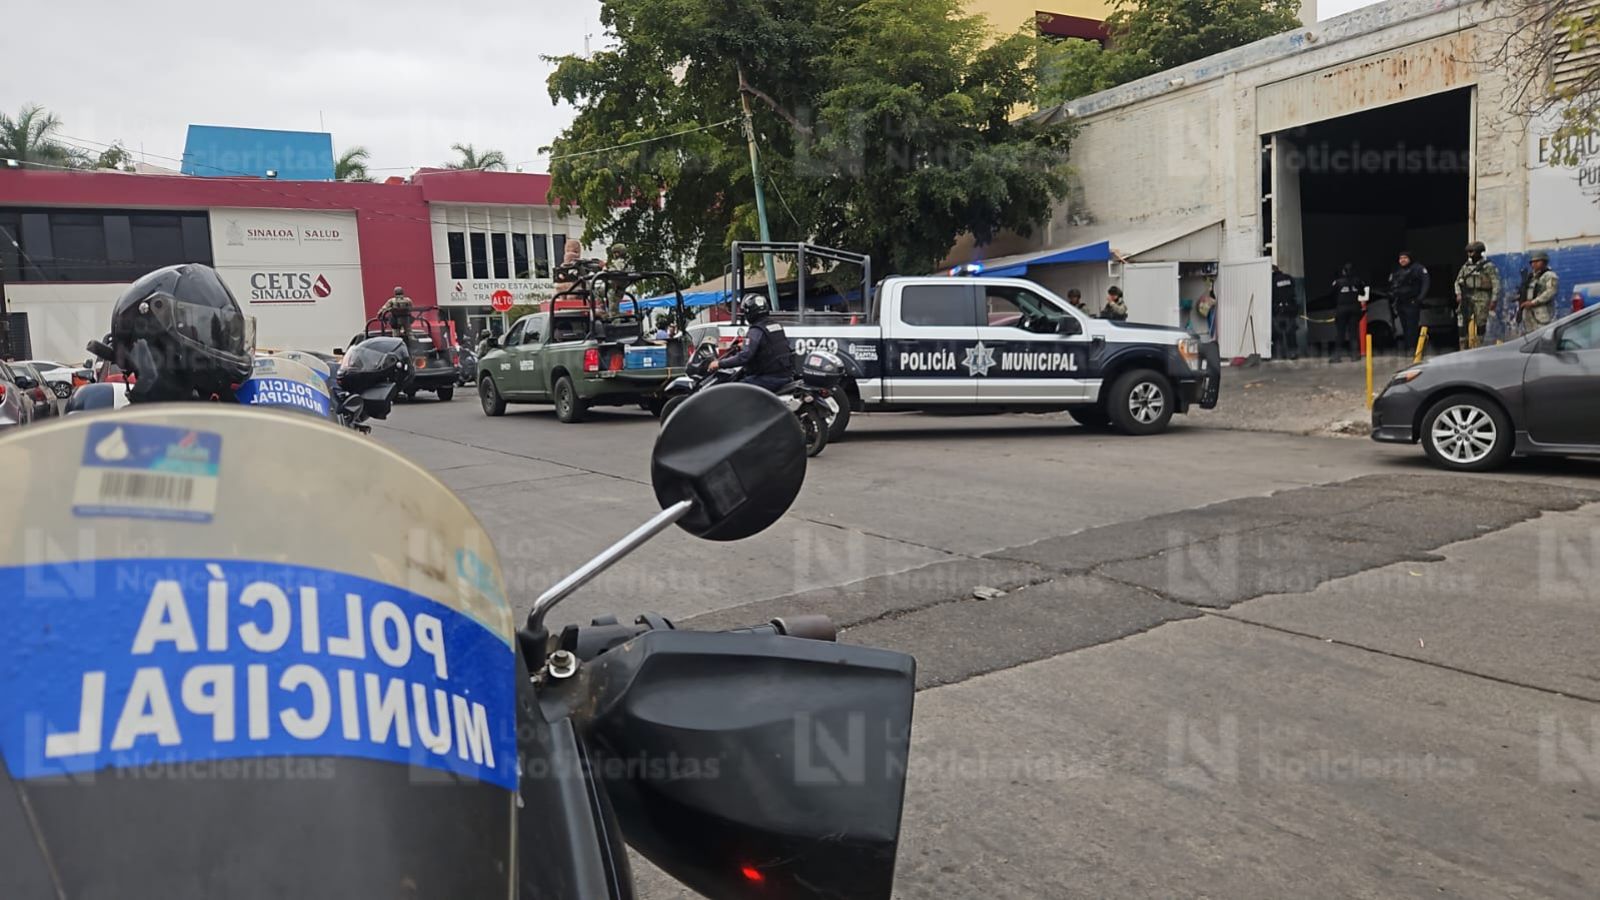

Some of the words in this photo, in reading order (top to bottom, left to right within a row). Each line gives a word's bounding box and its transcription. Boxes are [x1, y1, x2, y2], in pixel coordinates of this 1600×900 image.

[247, 229, 294, 238] SINALOA
[304, 230, 340, 238] SALUD
[250, 273, 312, 290] CETS
[251, 289, 312, 300] SINALOA
[492, 297, 512, 306] ALTO
[900, 348, 957, 371] POLICÍA
[1001, 352, 1078, 372] MUNICIPAL
